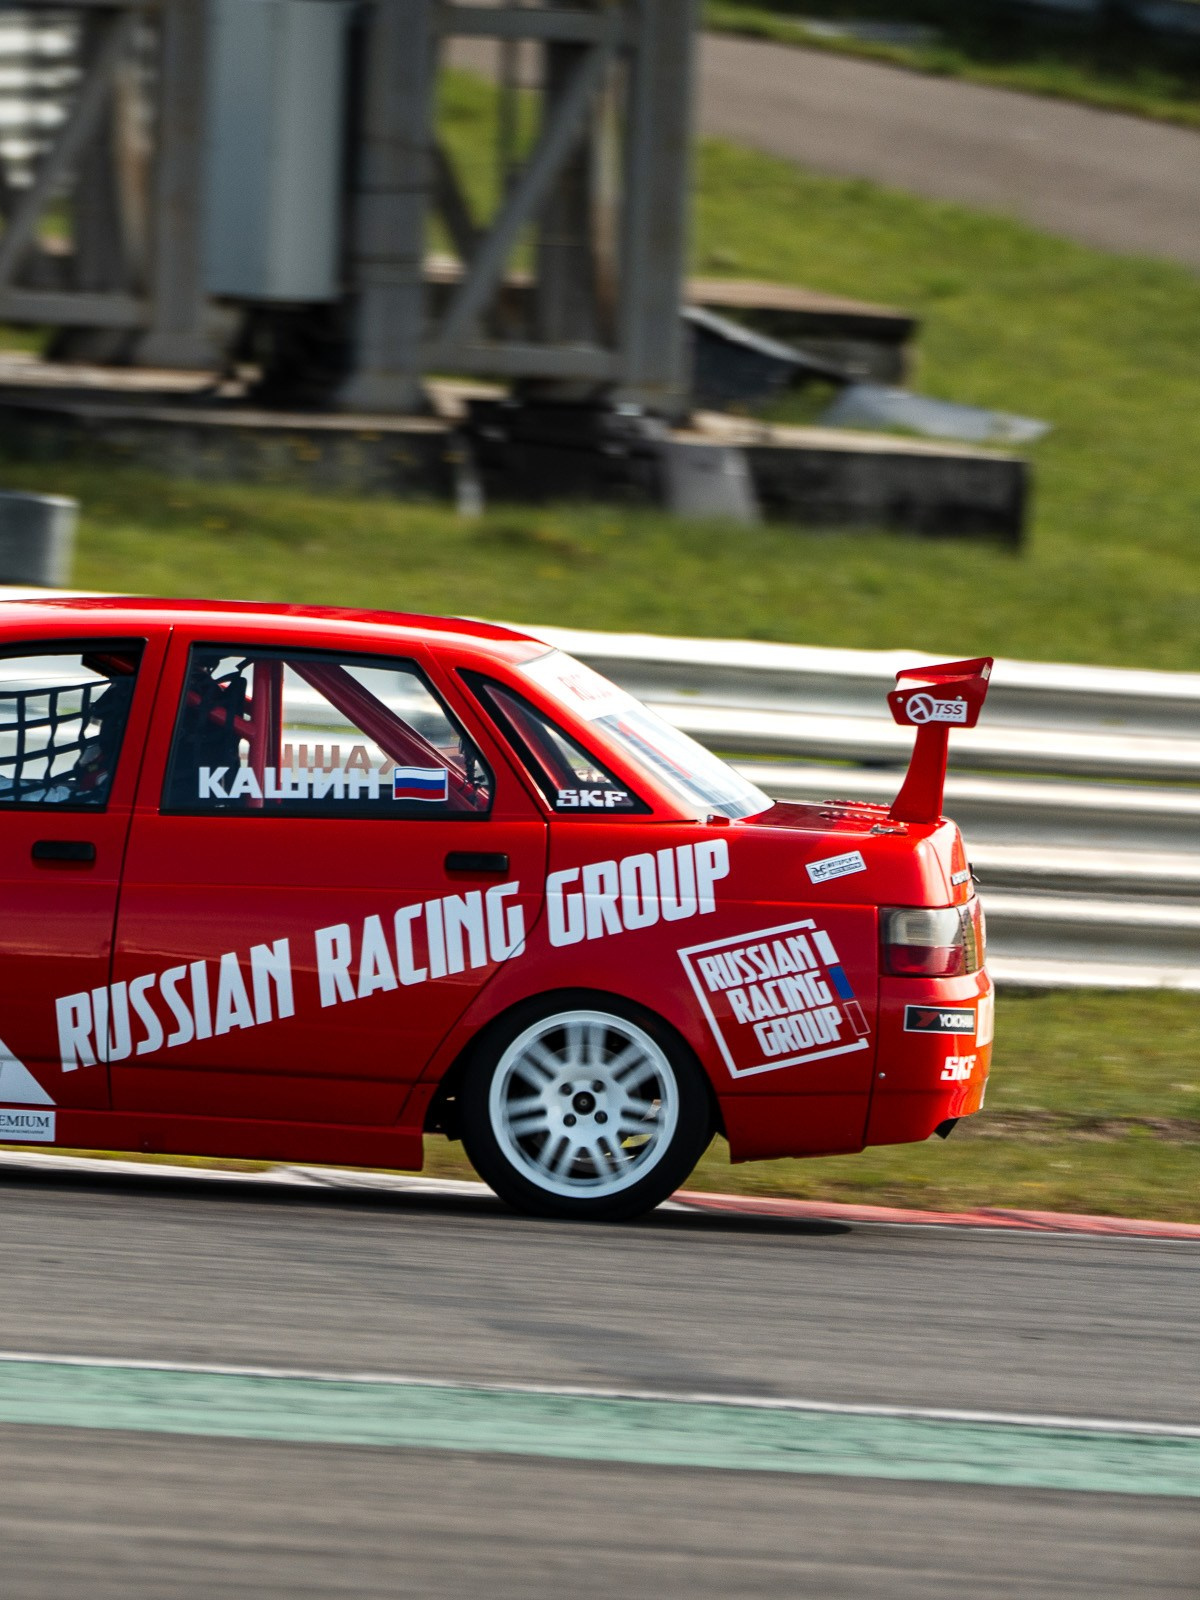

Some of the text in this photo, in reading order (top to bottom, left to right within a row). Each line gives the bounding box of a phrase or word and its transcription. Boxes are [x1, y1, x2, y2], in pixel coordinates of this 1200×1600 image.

[935, 703, 964, 715] TSS
[198, 766, 381, 800] КАШИН
[556, 789, 628, 808] SKF
[55, 839, 730, 1073] RUSSIAN RACING GROUP
[697, 934, 819, 992] RUSSIAN
[725, 970, 833, 1025] RACING
[753, 1005, 843, 1057] GROUP
